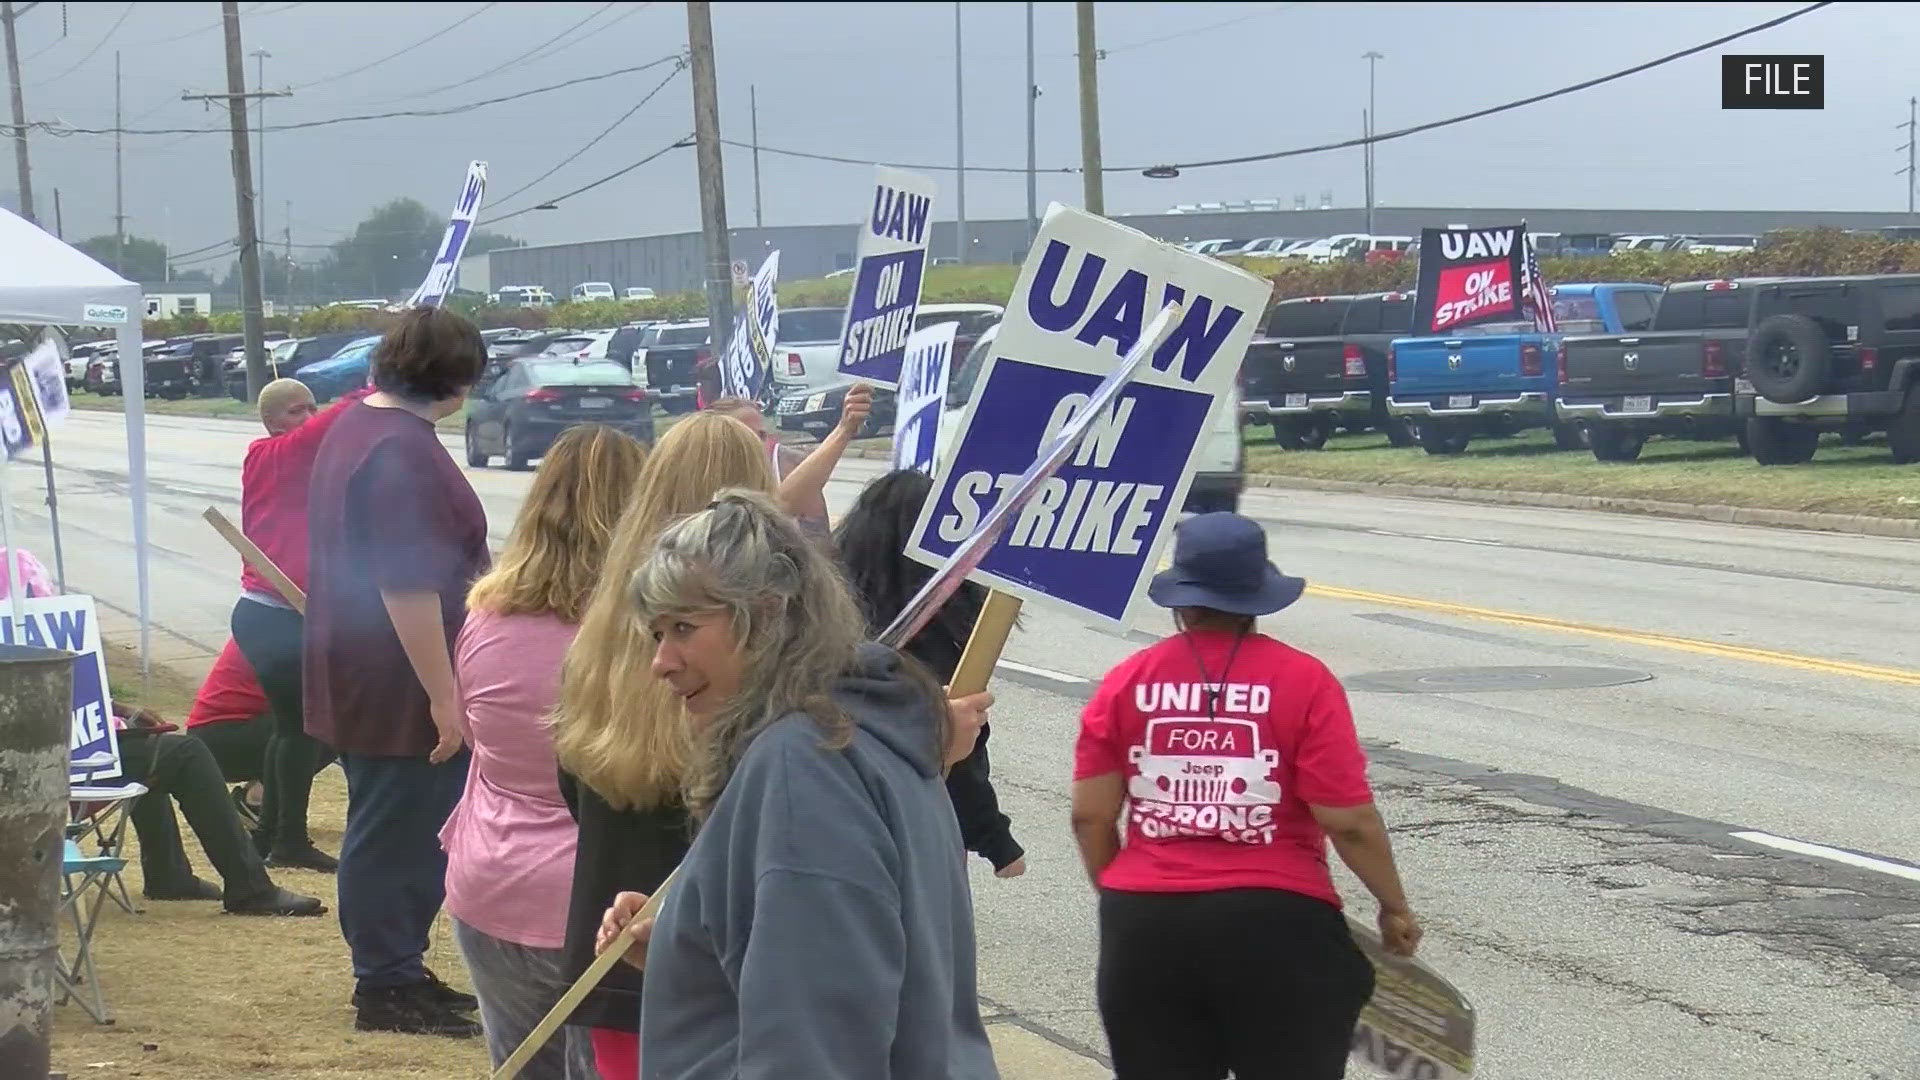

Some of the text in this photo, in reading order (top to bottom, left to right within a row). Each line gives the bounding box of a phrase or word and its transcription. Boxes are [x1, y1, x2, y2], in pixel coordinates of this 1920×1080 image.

[871, 184, 931, 245] UAW
[1439, 229, 1515, 260] UAW
[875, 260, 904, 311] ON
[1465, 269, 1495, 296] ON
[1027, 238, 1245, 384] UAW
[1436, 281, 1512, 326] STRIKE
[843, 304, 914, 367] STRIKE
[1135, 682, 1272, 714] UNITED
[1167, 728, 1236, 751] FOR A
[1181, 761, 1225, 778] Jeep
